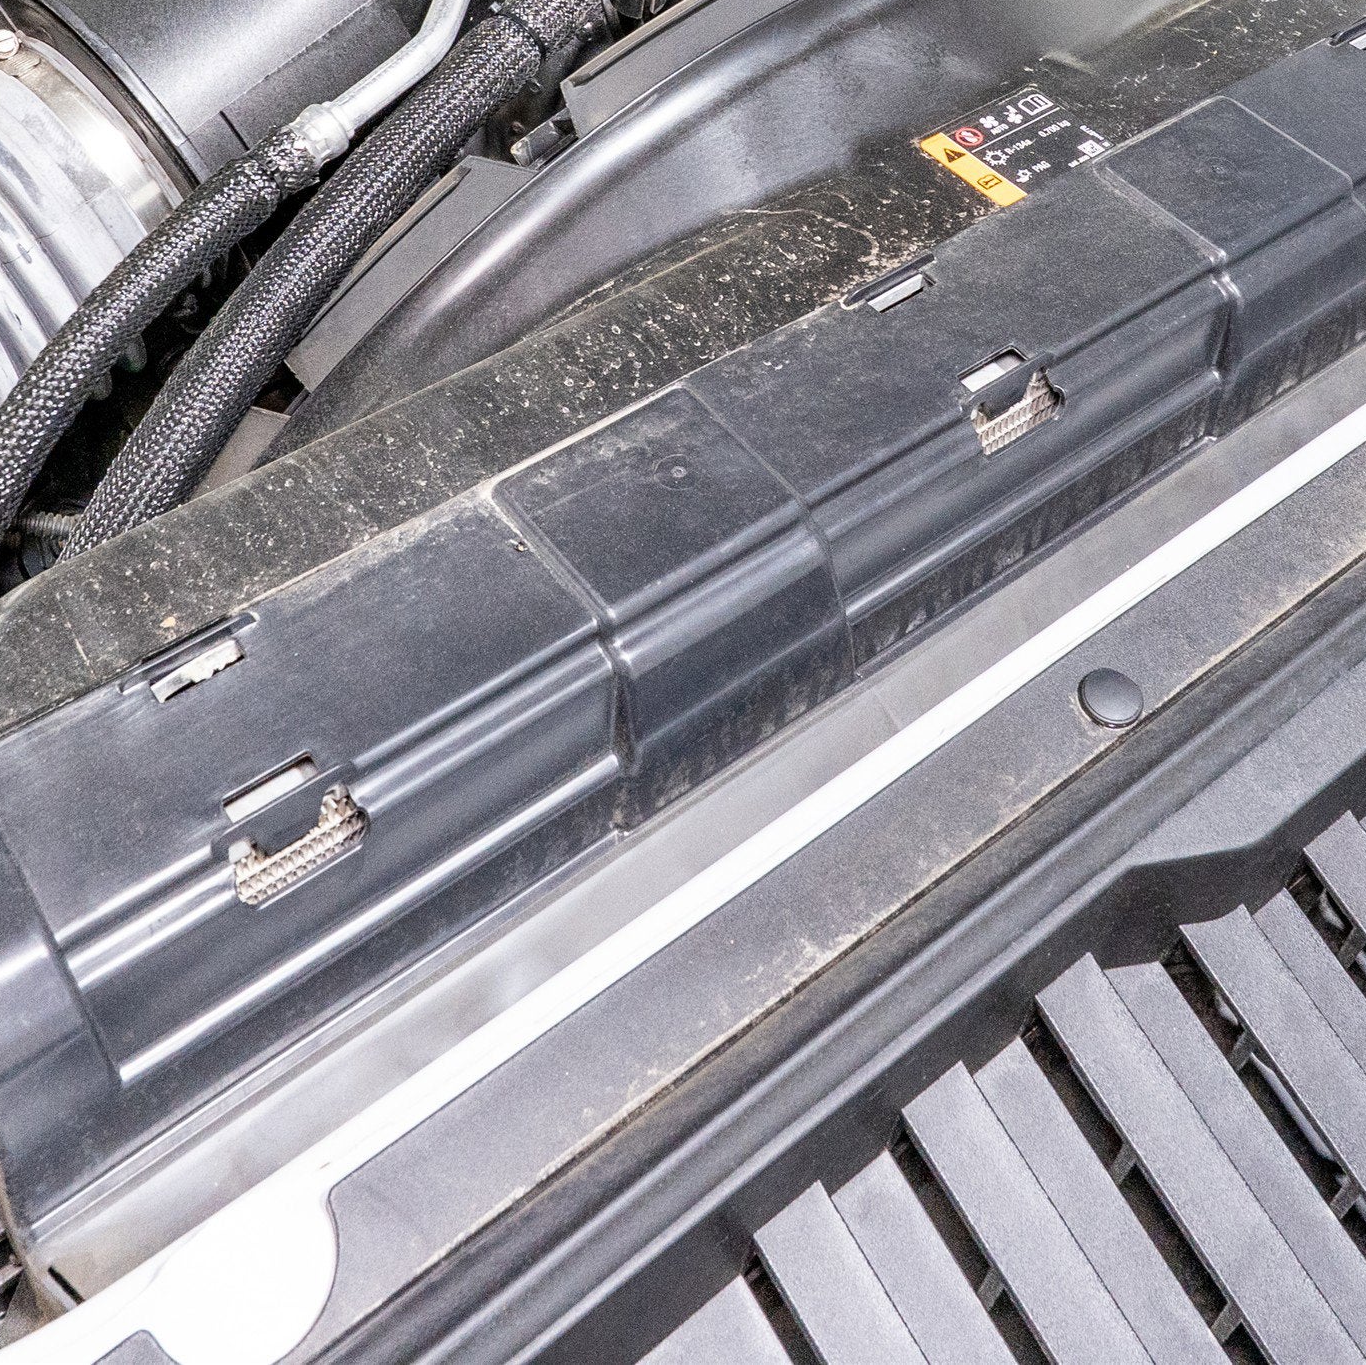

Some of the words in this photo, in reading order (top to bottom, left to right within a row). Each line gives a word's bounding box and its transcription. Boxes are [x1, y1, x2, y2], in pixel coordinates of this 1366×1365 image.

[1003, 139, 1033, 155] R-134a
[1056, 119, 1072, 129] kg
[1031, 160, 1052, 173] PAG
